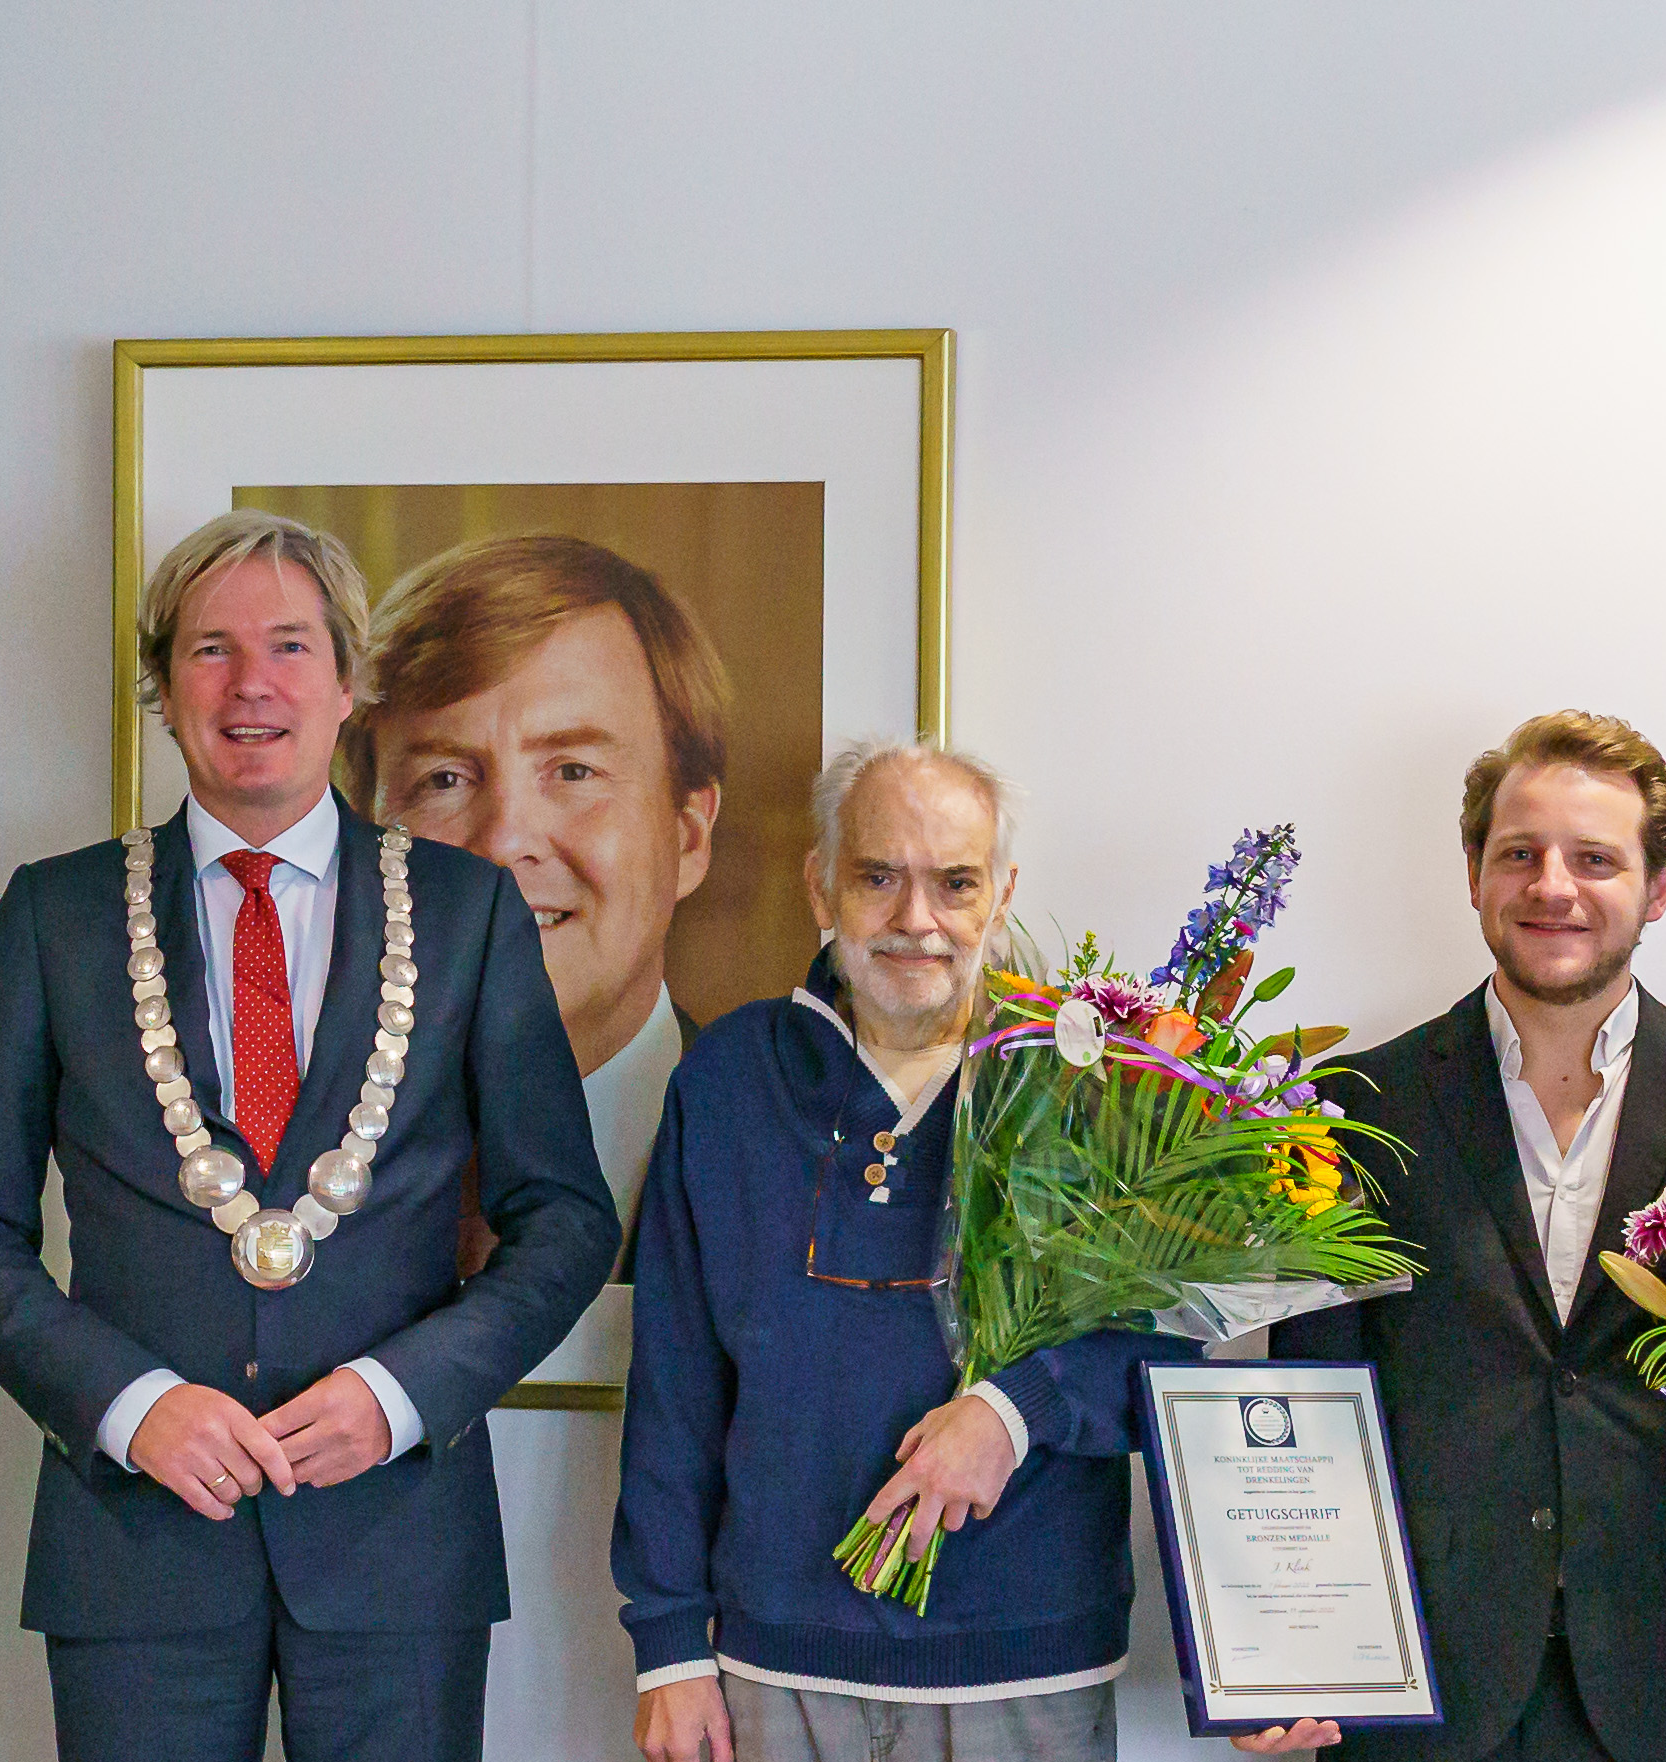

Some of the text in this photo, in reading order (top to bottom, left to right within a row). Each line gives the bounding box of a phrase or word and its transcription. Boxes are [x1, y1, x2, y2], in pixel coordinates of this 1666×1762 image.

[1213, 1455, 1334, 1465] KONINKLIJKE MAATSCHAPPIJ
[1236, 1465, 1315, 1474] TOT REDDING VAN
[1245, 1476, 1311, 1484] DRENKELINGEN
[1226, 1508, 1341, 1521] GETUIGSCHRIFT
[1246, 1534, 1331, 1543] BRONZEN MEDAILLE
